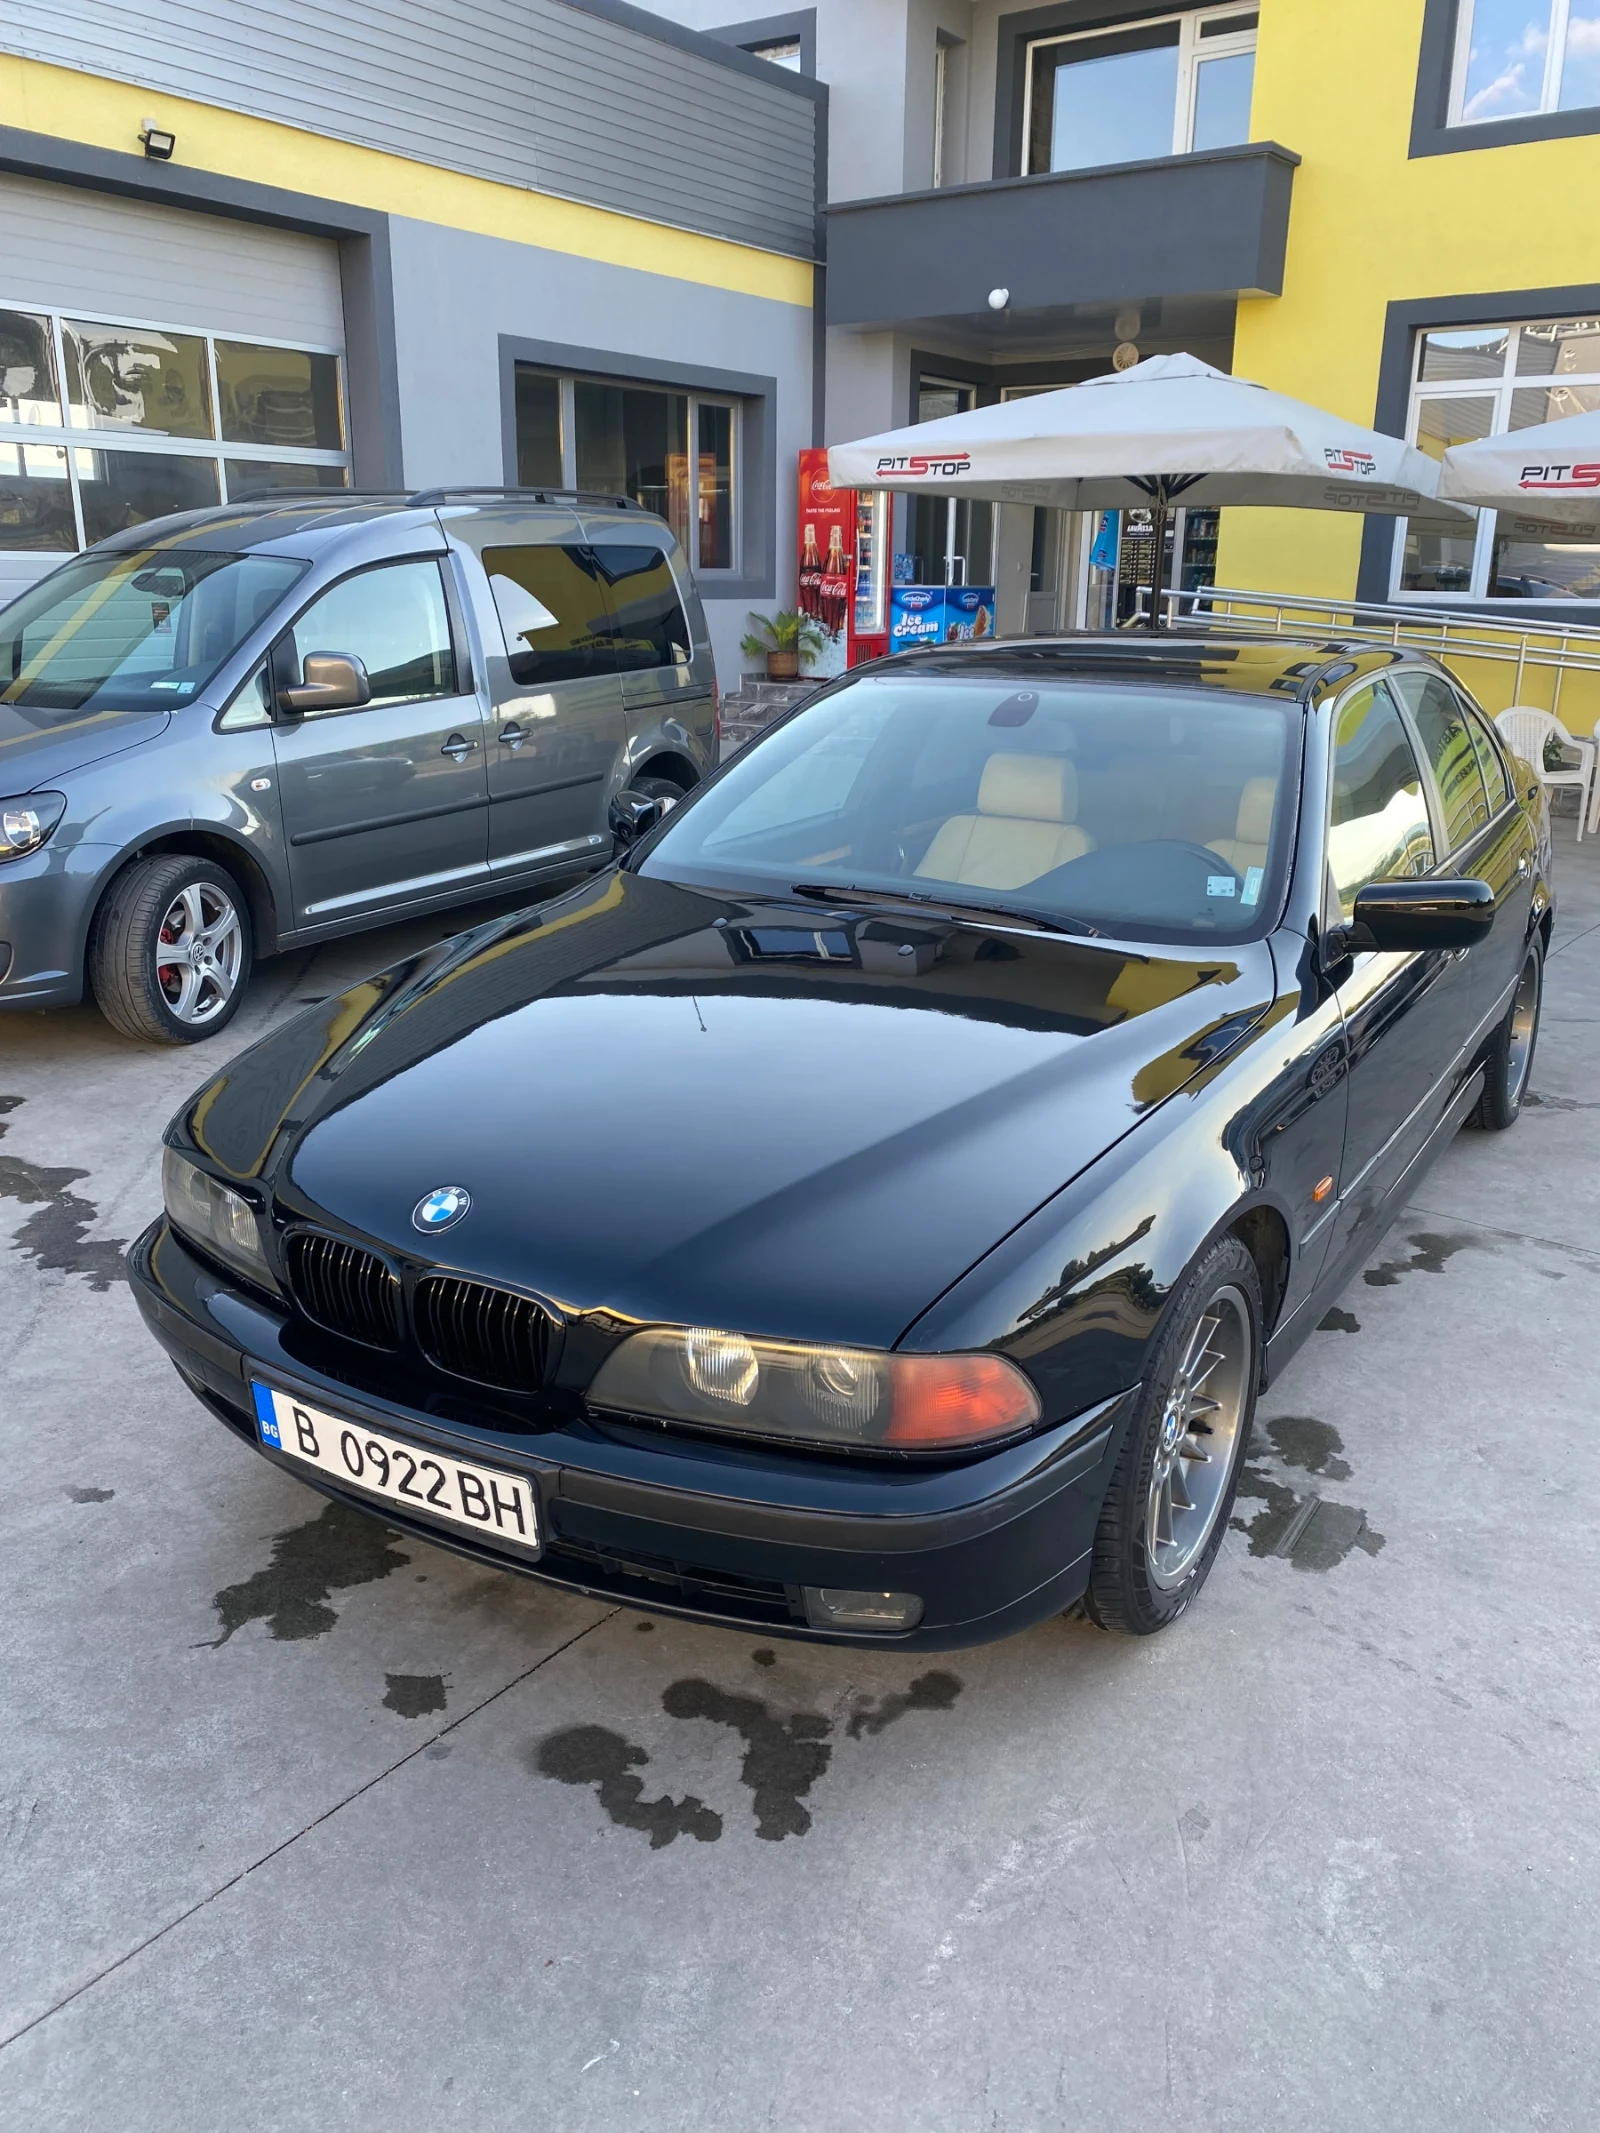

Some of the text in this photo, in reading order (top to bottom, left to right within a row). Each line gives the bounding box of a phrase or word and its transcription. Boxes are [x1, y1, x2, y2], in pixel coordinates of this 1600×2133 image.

[1518, 464, 1600, 489] PITS
[893, 622, 939, 637] Cream
[901, 613, 922, 626] Ice
[261, 1419, 279, 1439] BG
[292, 1405, 320, 1458] B
[1137, 1381, 1168, 1504] UNIROYAL
